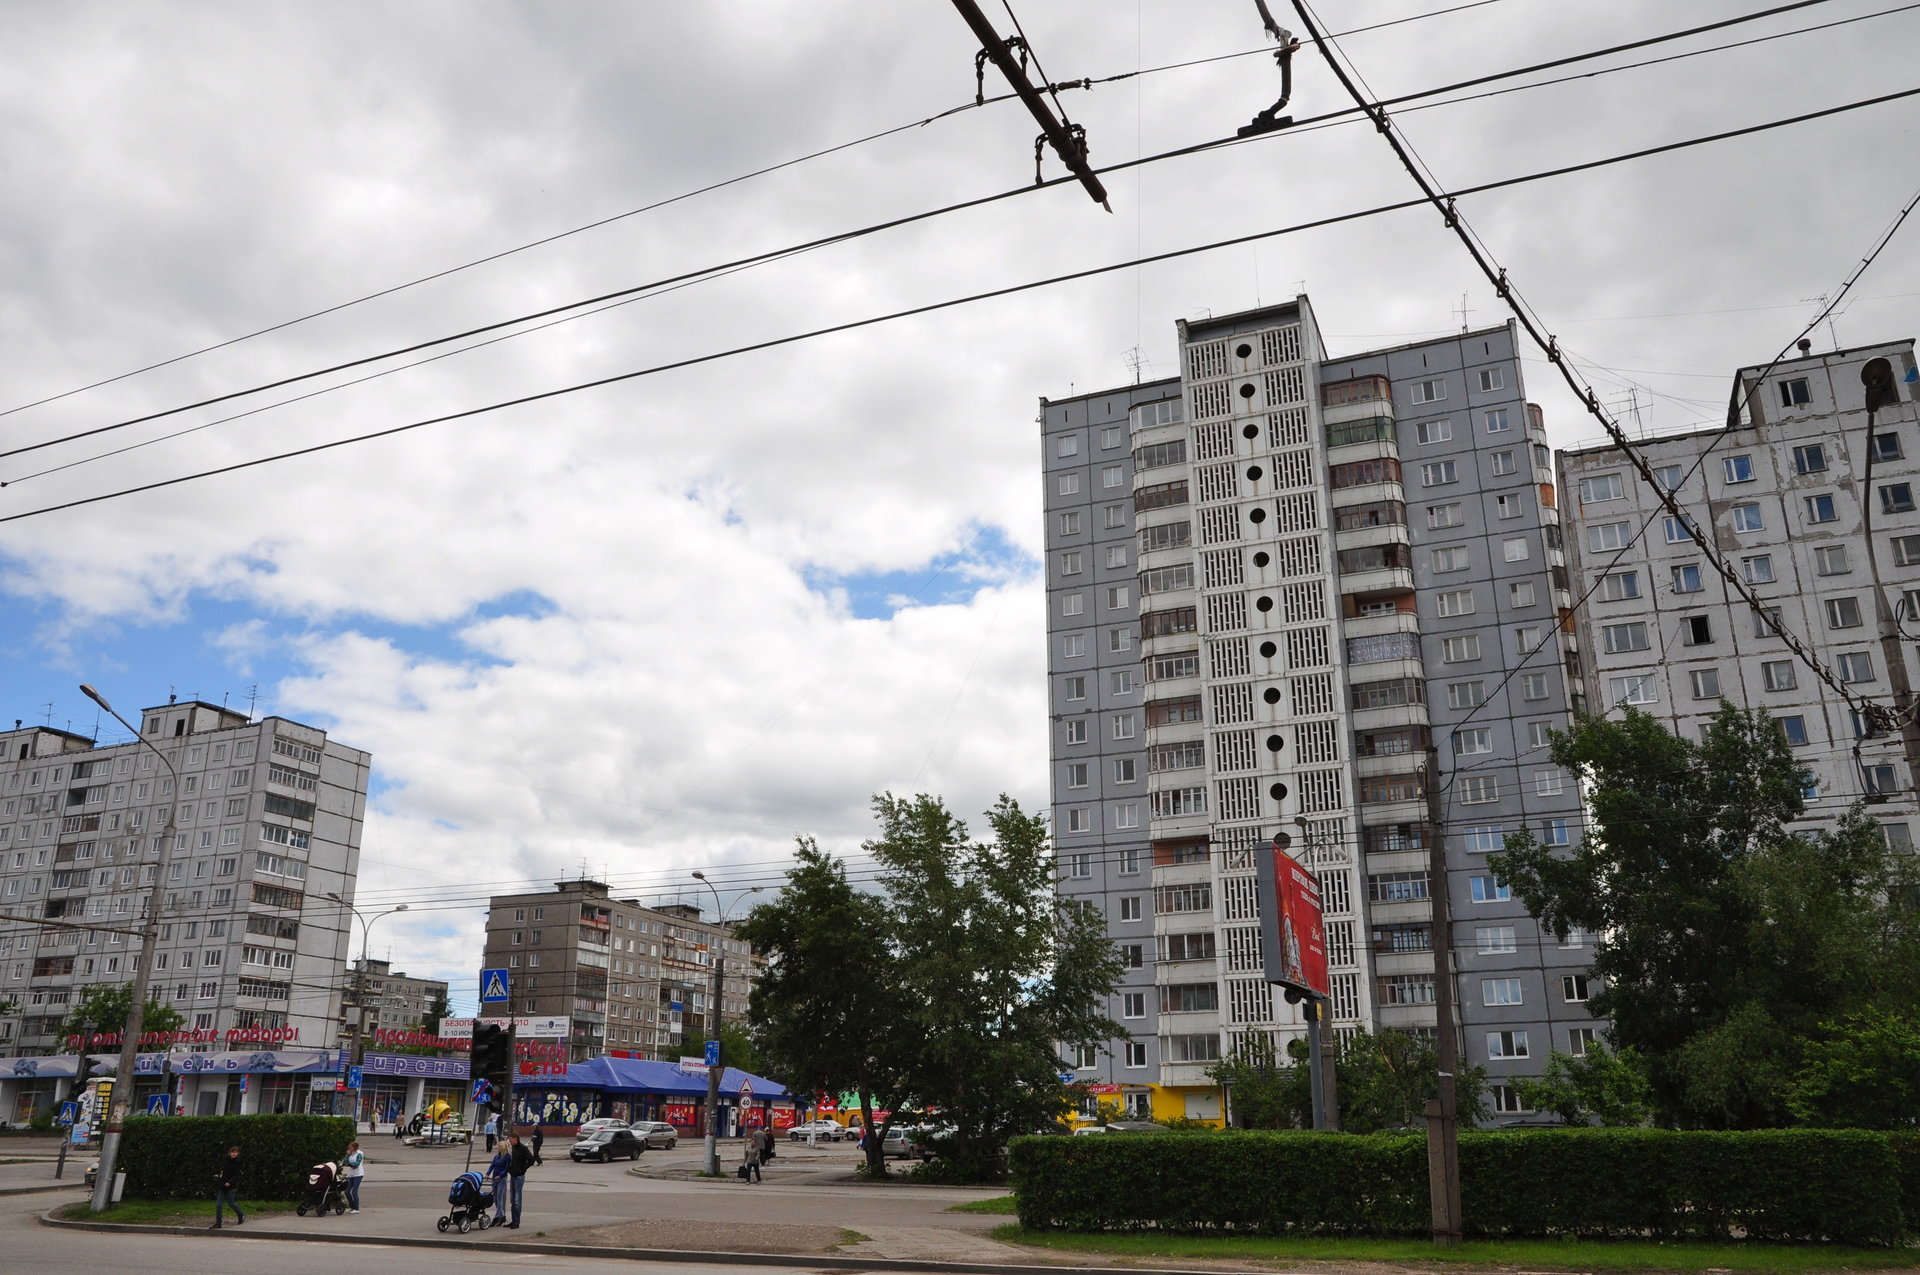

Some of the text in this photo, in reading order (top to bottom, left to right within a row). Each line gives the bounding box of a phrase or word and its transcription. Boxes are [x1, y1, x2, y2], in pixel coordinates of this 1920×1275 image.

[445, 1019, 529, 1027] БЕЗОПАНОСТЬ-010
[225, 1022, 299, 1046] товары
[375, 1027, 473, 1050] промышлен
[140, 1058, 239, 1075] ирень
[373, 1057, 466, 1075] ирень
